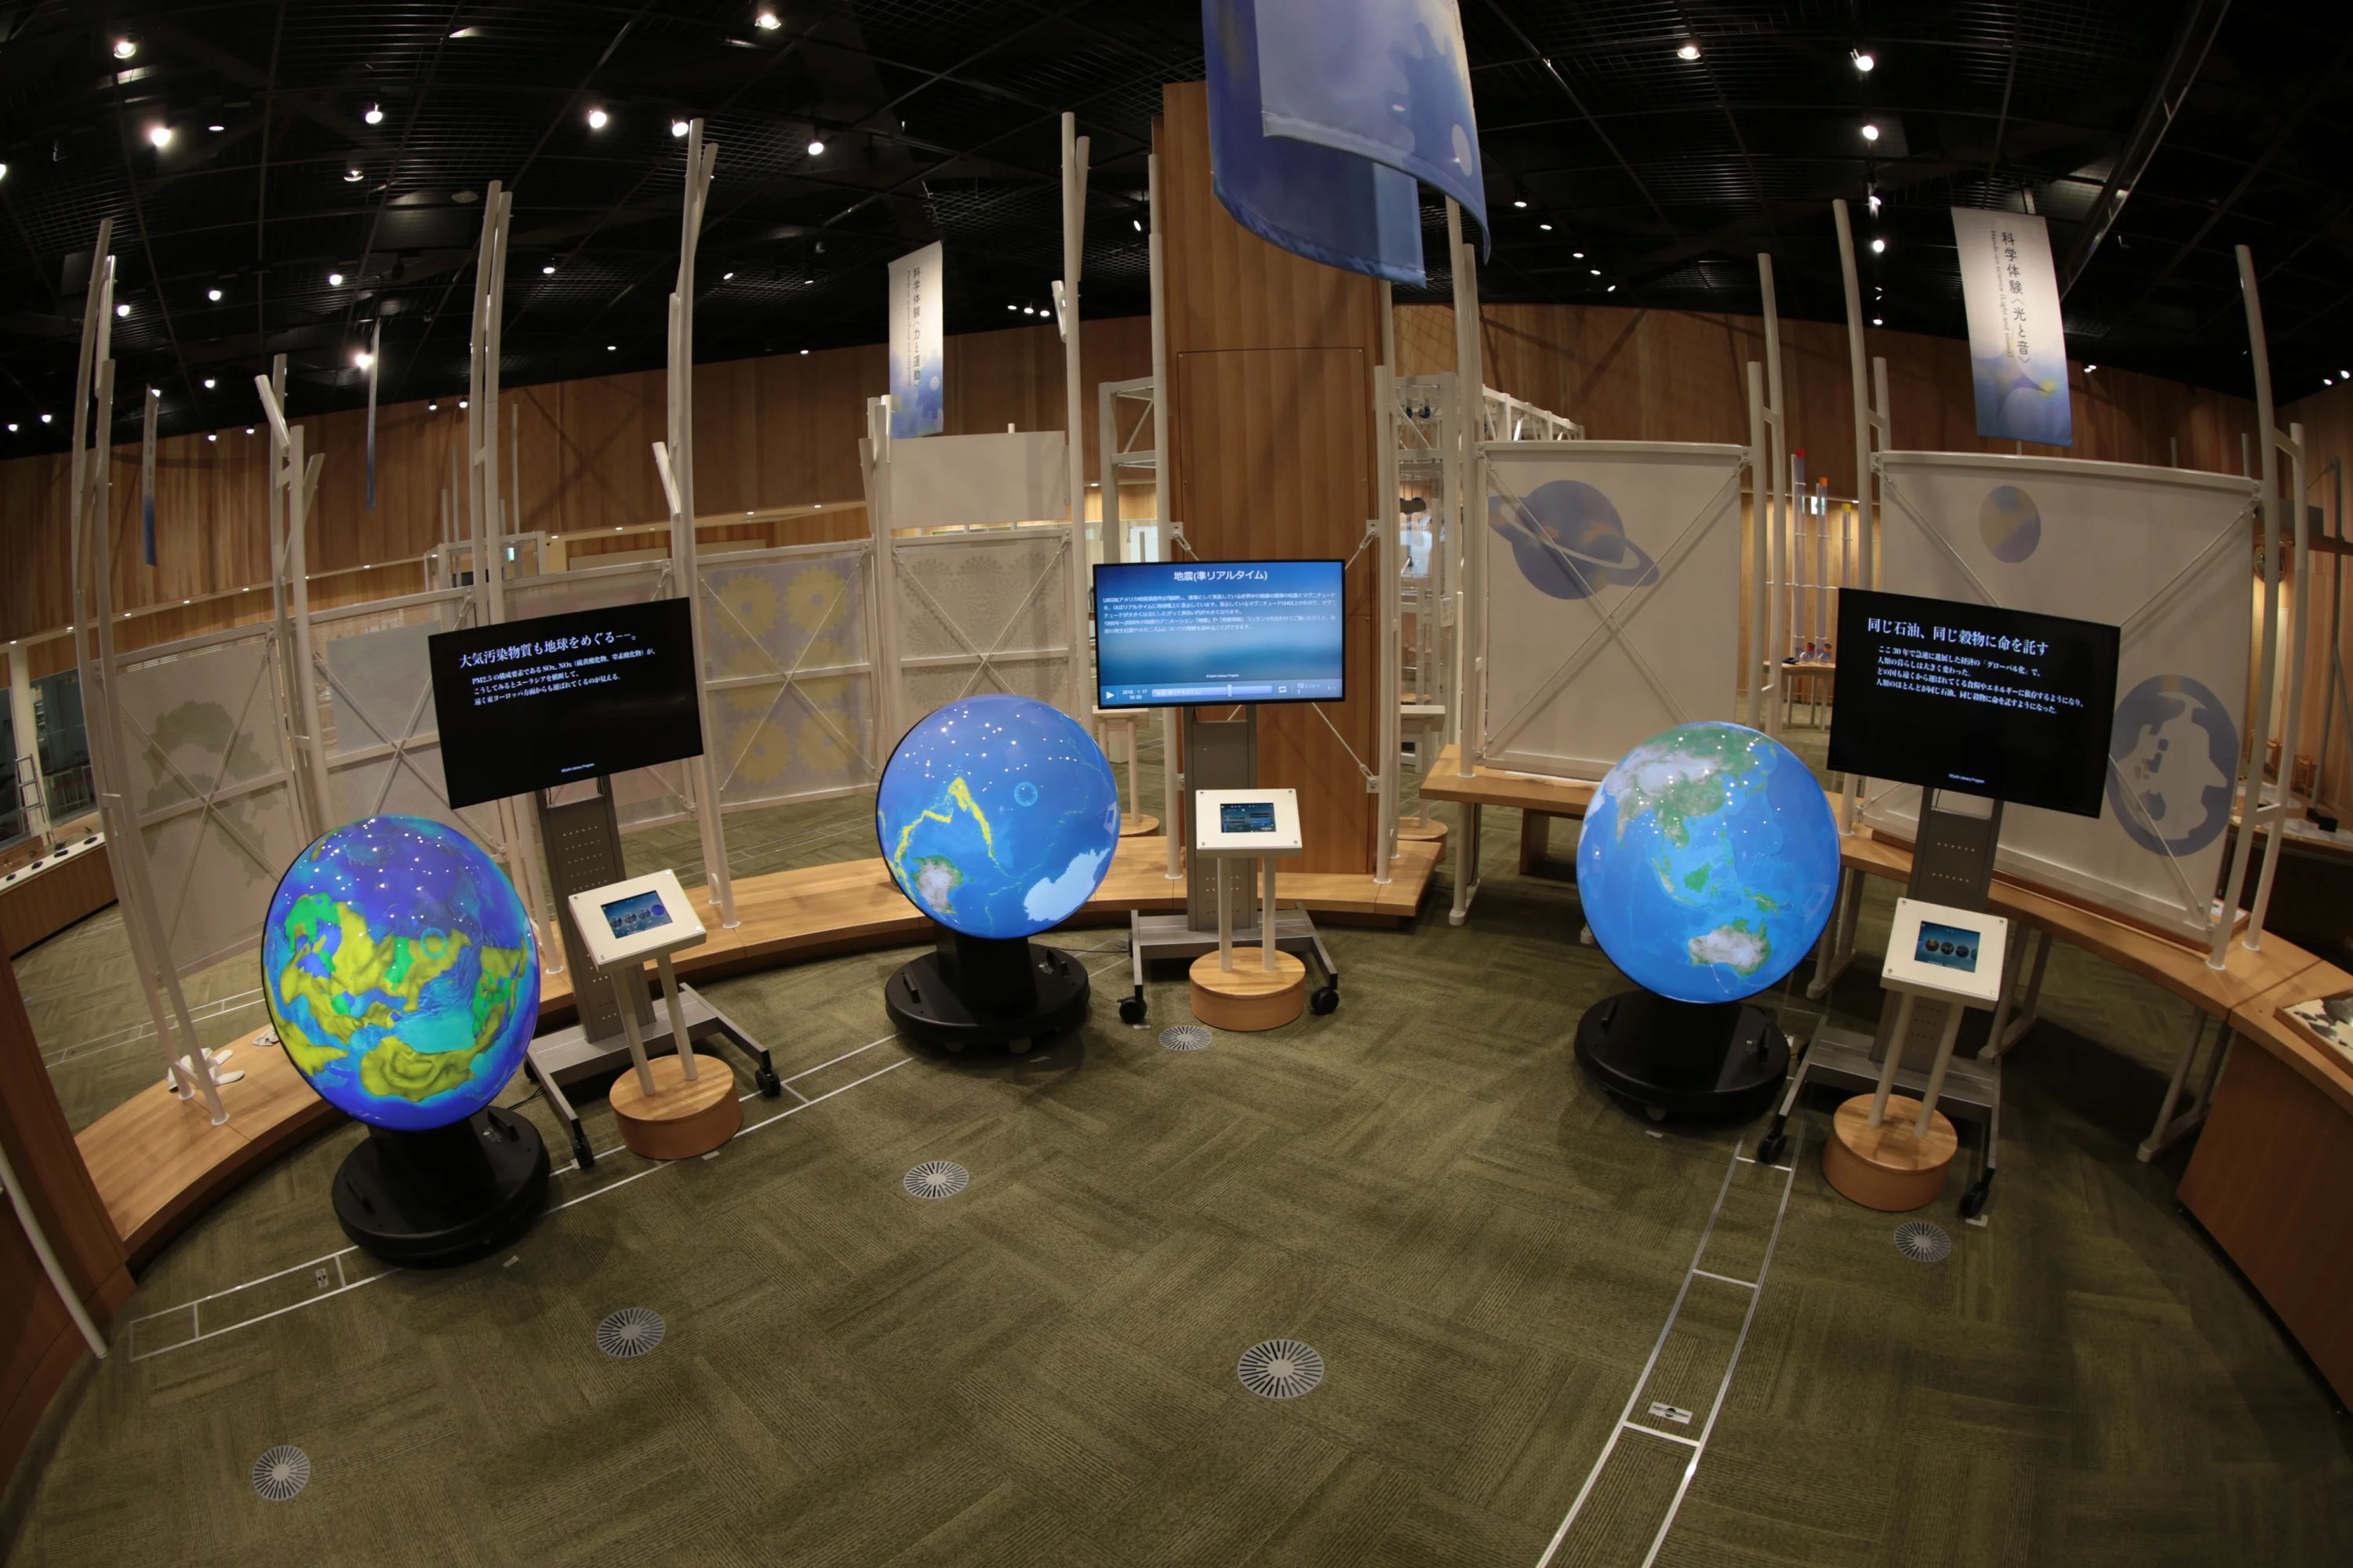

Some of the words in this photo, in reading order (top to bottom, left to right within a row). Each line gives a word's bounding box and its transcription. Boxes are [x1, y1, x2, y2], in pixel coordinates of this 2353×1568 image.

[1990, 230, 2001, 264] Hands-on
[1996, 266, 2006, 292] science
[1174, 570, 1267, 581] 地震(準リアルタイム)
[1867, 617, 2049, 656] 同じ石油、同じ穀物に命を託す
